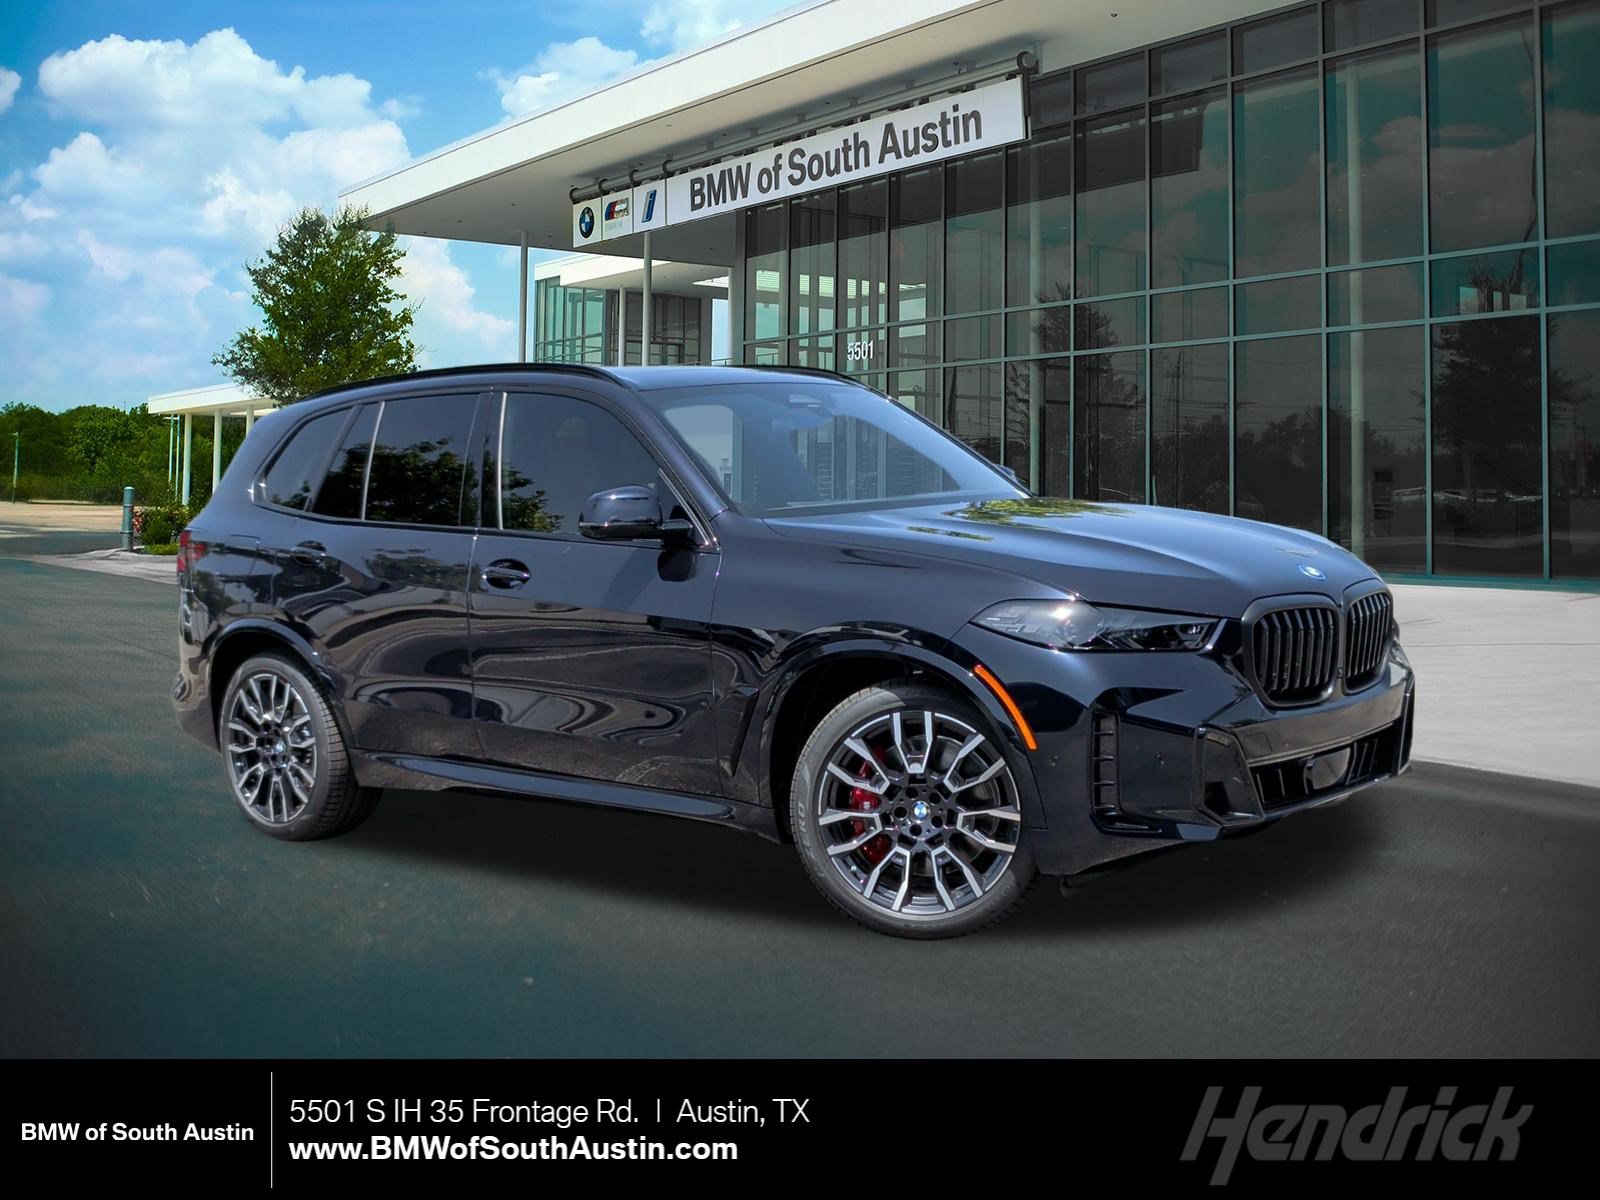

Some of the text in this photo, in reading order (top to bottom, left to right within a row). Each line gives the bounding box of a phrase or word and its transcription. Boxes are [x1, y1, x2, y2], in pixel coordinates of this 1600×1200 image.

[690, 104, 983, 212] BMW of South Austin
[847, 340, 873, 361] 5501
